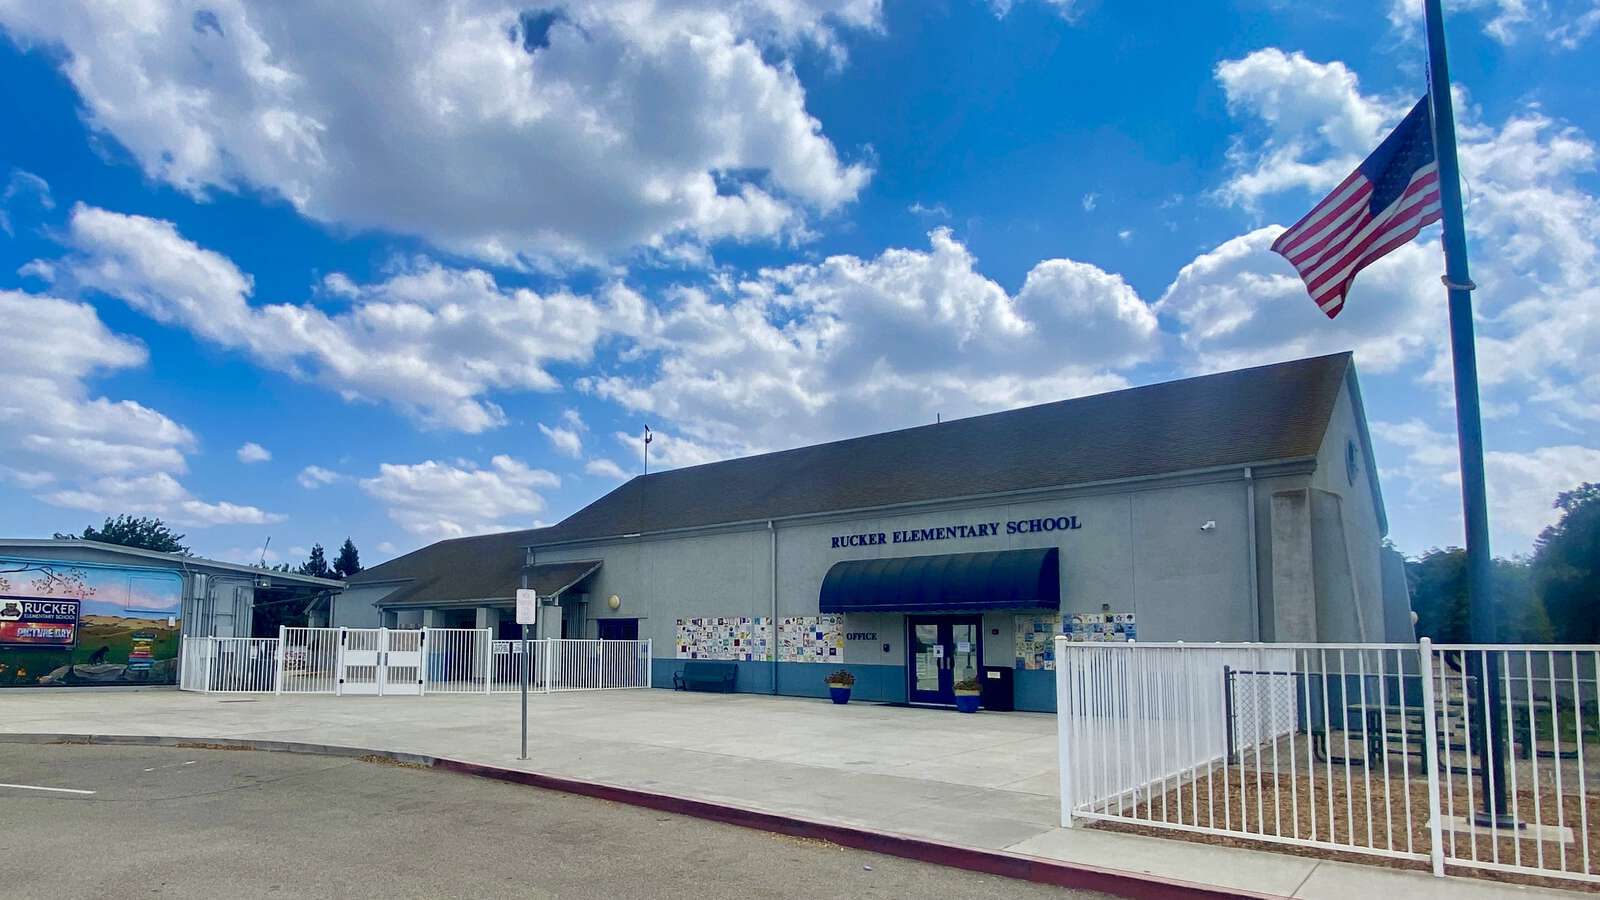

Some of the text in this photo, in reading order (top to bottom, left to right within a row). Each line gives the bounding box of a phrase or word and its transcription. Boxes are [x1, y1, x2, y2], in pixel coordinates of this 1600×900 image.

[831, 515, 1082, 548] RUCKER ELEMENTARY SCHOOL
[24, 603, 76, 614] RUCKER
[846, 632, 878, 641] OFFICE
